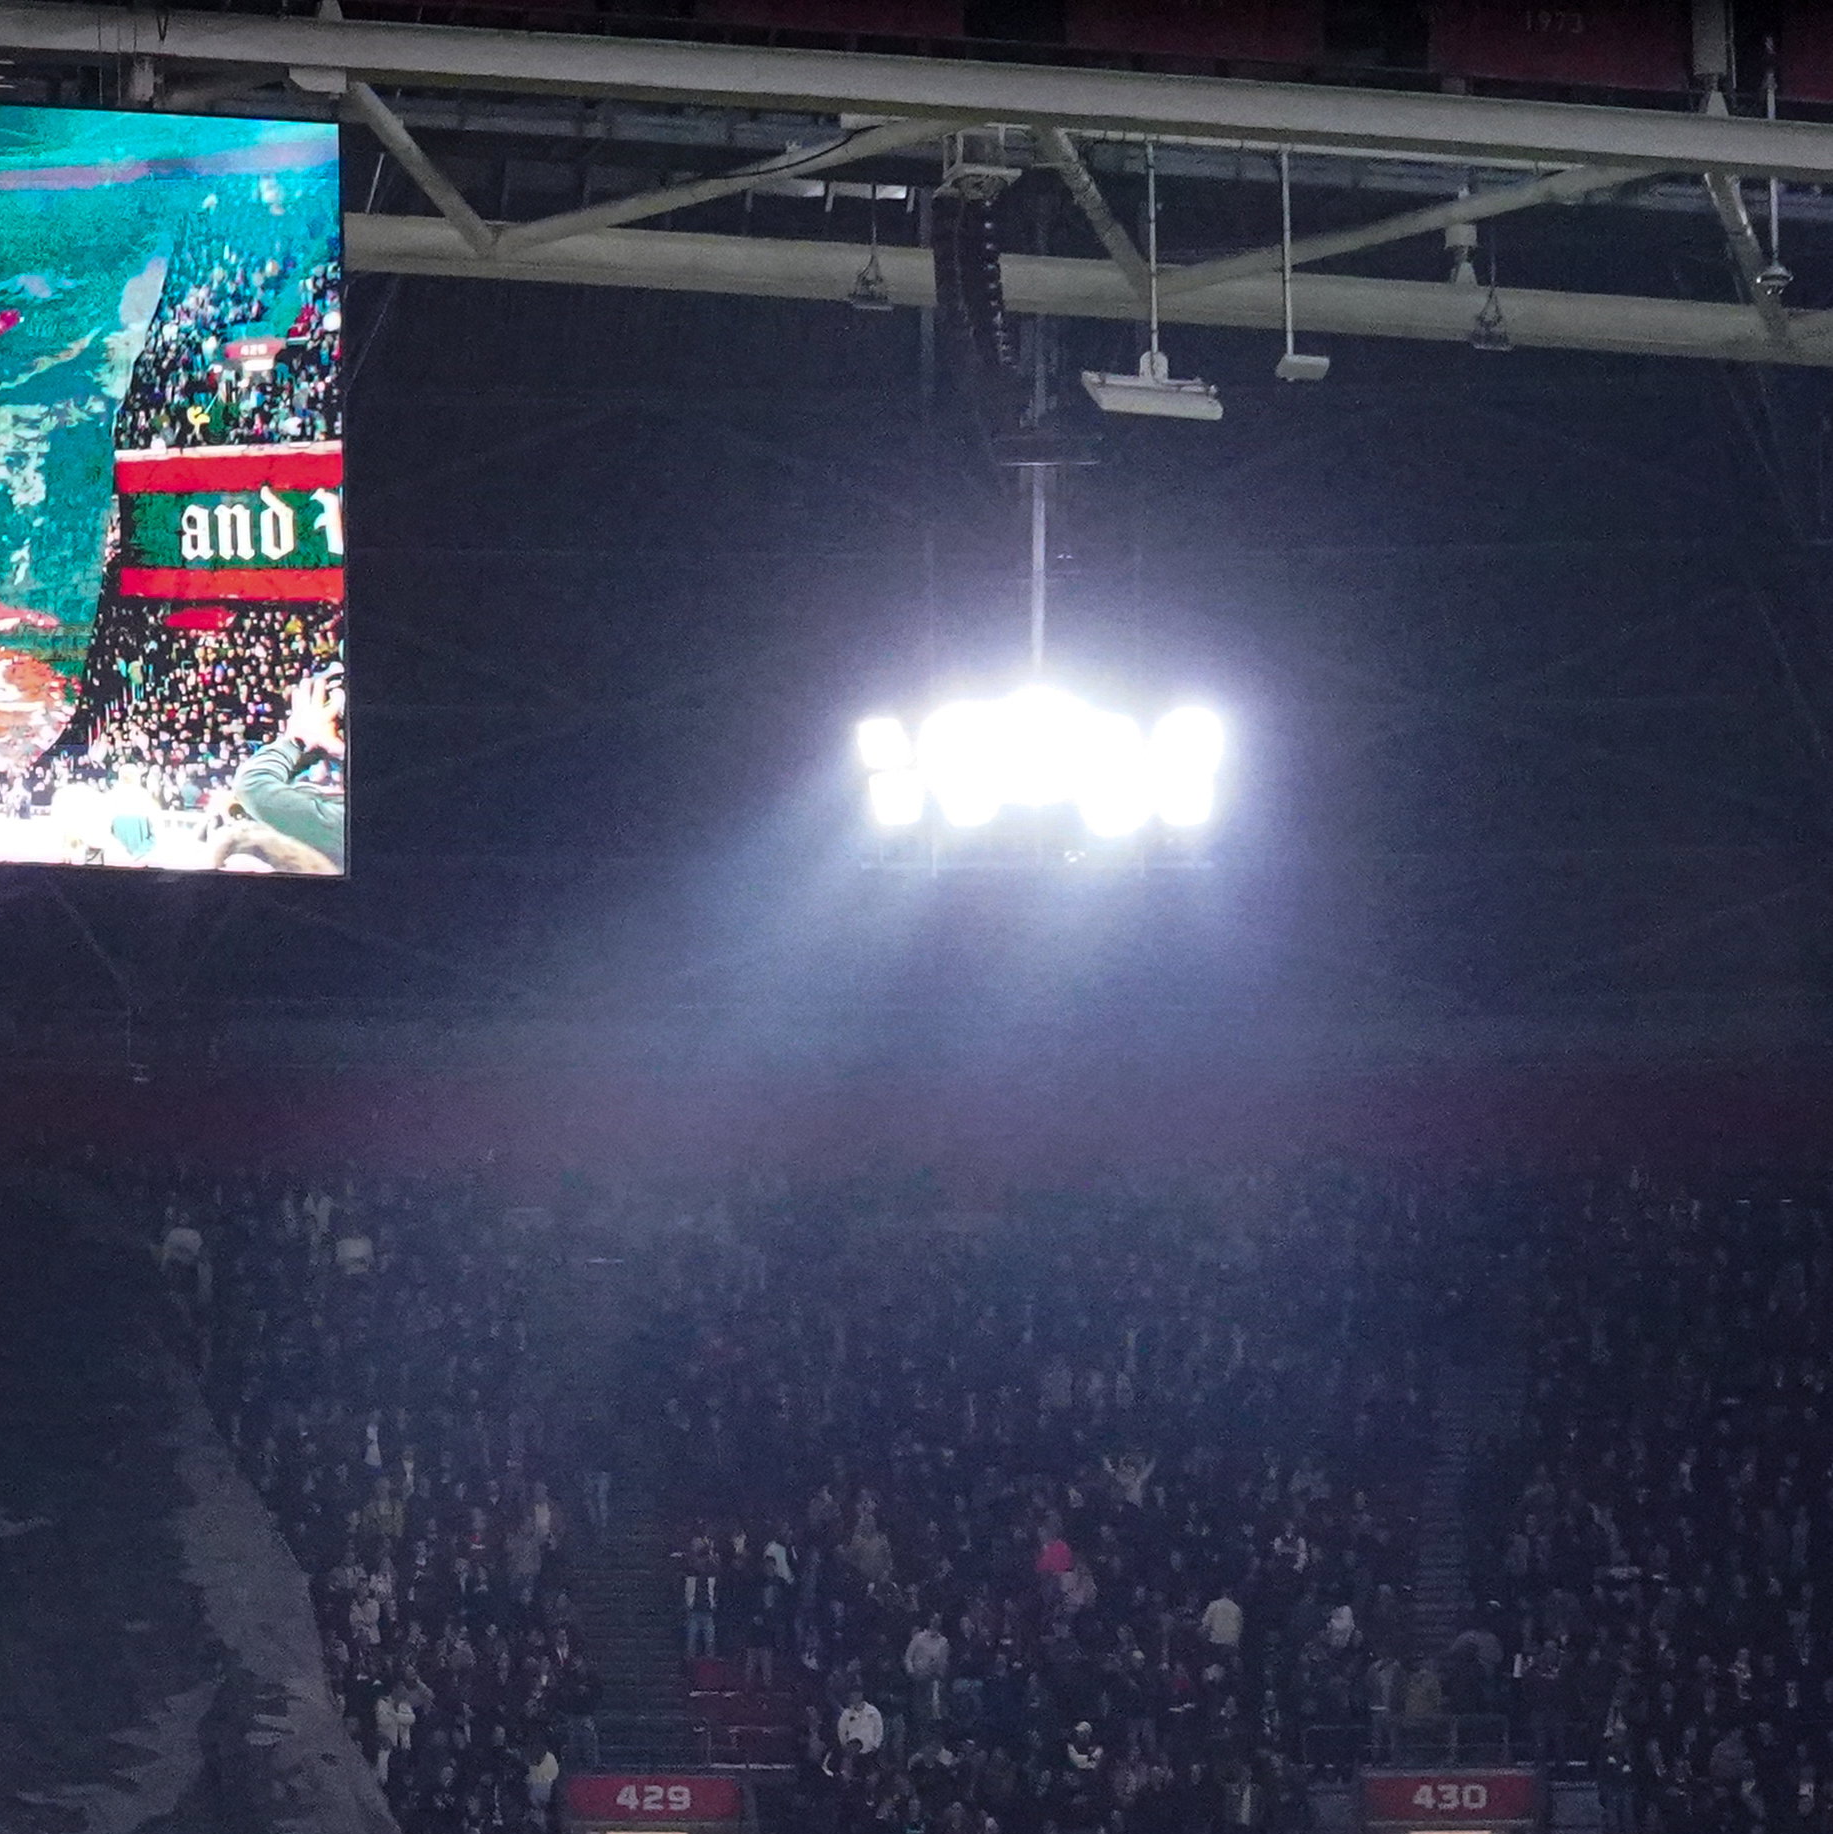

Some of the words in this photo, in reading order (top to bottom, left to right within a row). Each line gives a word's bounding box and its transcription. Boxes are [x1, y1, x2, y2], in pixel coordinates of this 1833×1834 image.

[181, 486, 296, 560] and
[616, 1785, 691, 1811] 429
[1412, 1784, 1488, 1810] 430
